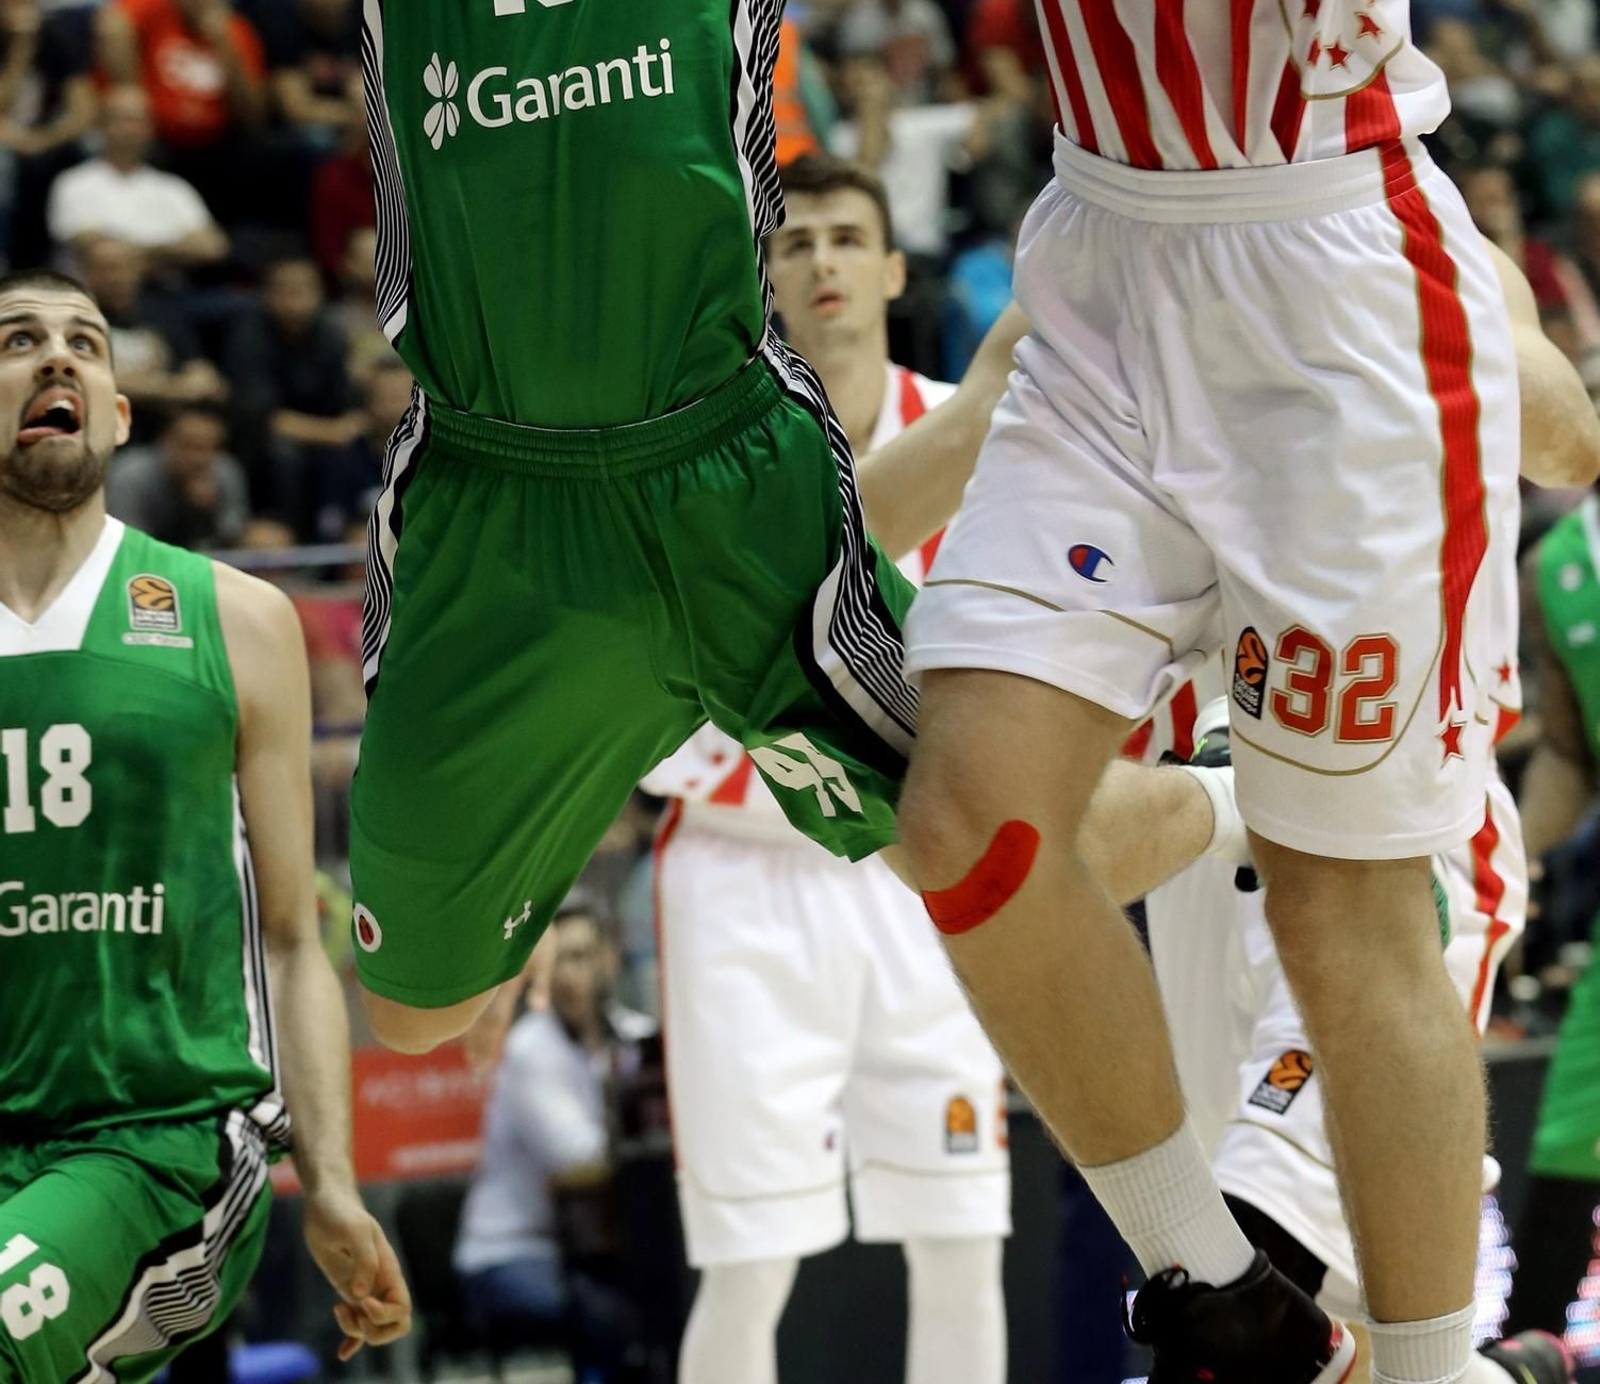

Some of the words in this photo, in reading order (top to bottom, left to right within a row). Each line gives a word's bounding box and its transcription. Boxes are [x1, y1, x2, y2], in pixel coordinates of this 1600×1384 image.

[466, 37, 674, 128] Garanti
[1267, 623, 1401, 745] 32
[1, 723, 92, 834] 18
[747, 731, 864, 817] 45
[0, 882, 165, 937] Garanti
